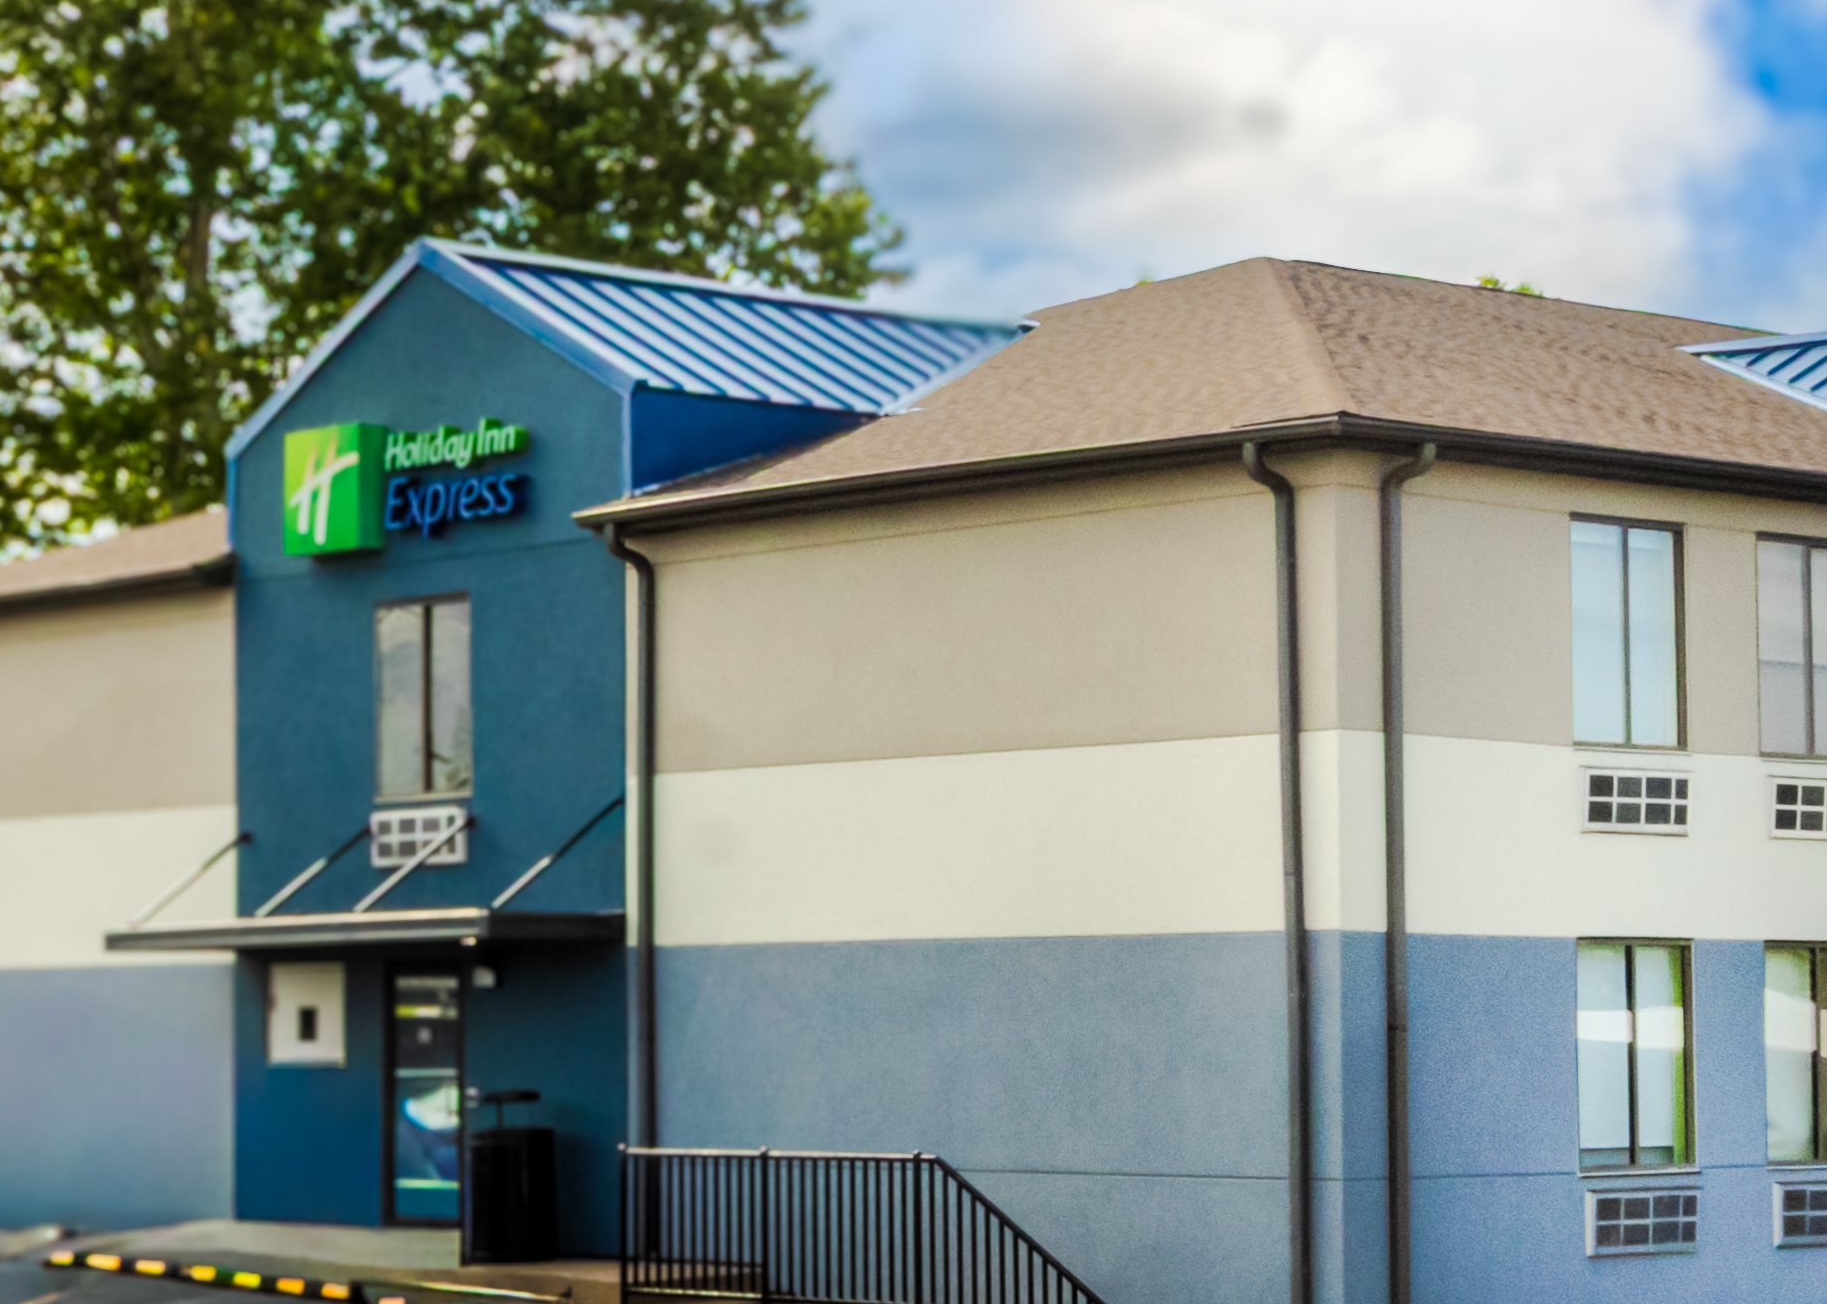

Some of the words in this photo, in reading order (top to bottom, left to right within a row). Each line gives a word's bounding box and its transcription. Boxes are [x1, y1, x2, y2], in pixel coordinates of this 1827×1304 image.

[384, 427, 474, 470] Holiday
[476, 416, 517, 456] Inn
[384, 473, 516, 537] Express
